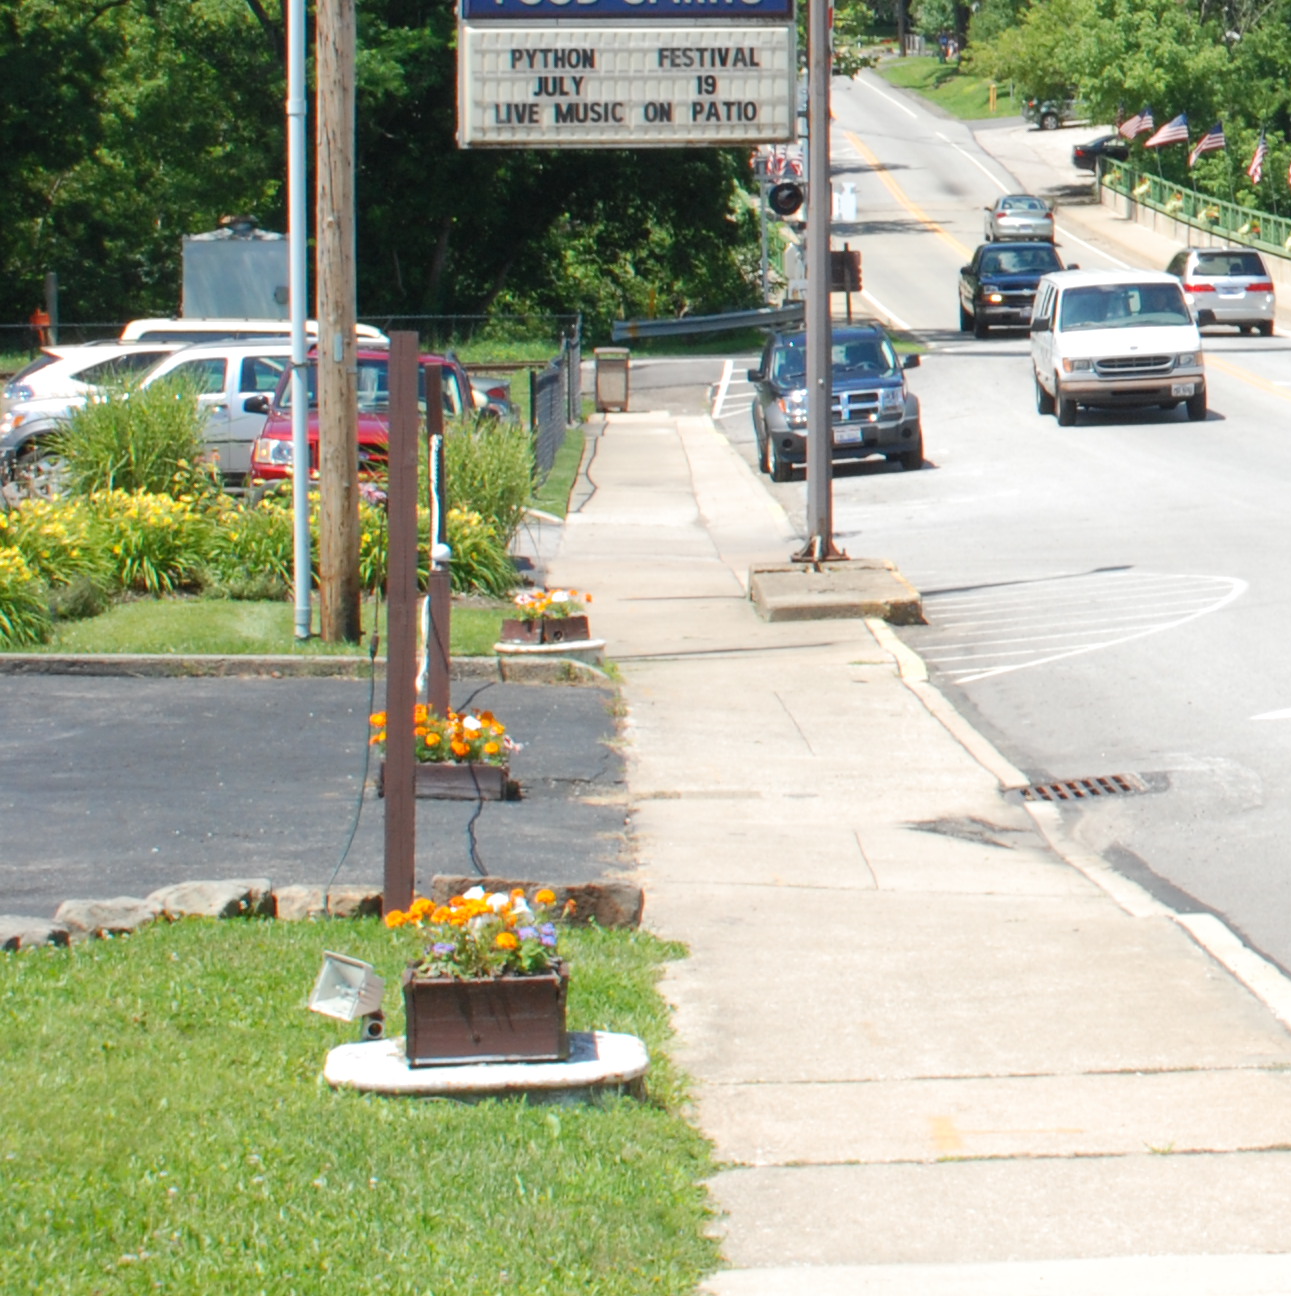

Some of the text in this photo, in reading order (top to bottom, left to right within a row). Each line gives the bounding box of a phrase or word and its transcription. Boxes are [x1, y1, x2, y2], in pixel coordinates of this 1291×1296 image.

[510, 47, 760, 70] PYTHON FESTIVAL
[533, 74, 717, 97] JULY 19
[495, 101, 757, 124] LIVE MUSIC ON PATIO
